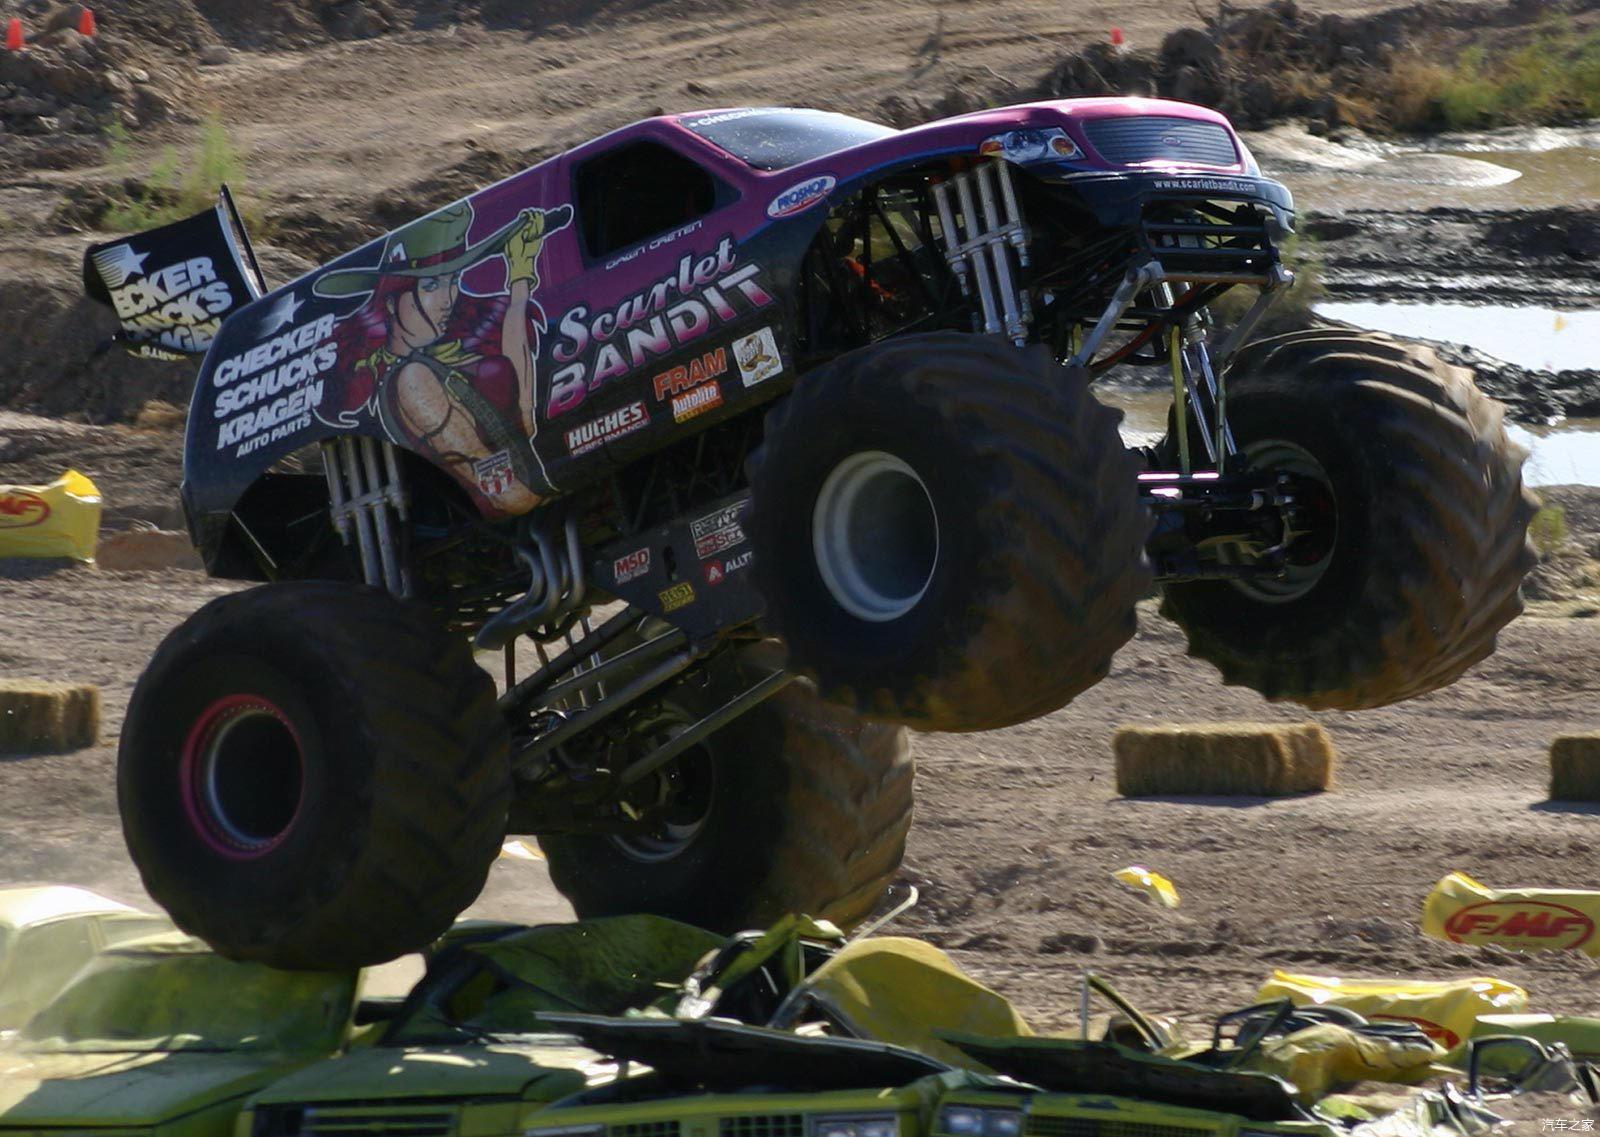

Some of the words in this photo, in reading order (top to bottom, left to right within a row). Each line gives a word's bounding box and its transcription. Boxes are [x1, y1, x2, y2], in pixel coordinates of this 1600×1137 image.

[1153, 179, 1257, 192] www.scarletbandit.com
[552, 237, 738, 363] Scarlet
[213, 312, 335, 388] CHECKER
[547, 263, 775, 419] BANDIT
[652, 347, 728, 402] FRAM
[217, 379, 325, 450] KRAGEN
[236, 433, 270, 458] AUTO
[271, 413, 312, 442] PARTS
[568, 401, 643, 449] HUGHES
[616, 549, 649, 575] MSD
[1450, 911, 1588, 938] FMF
